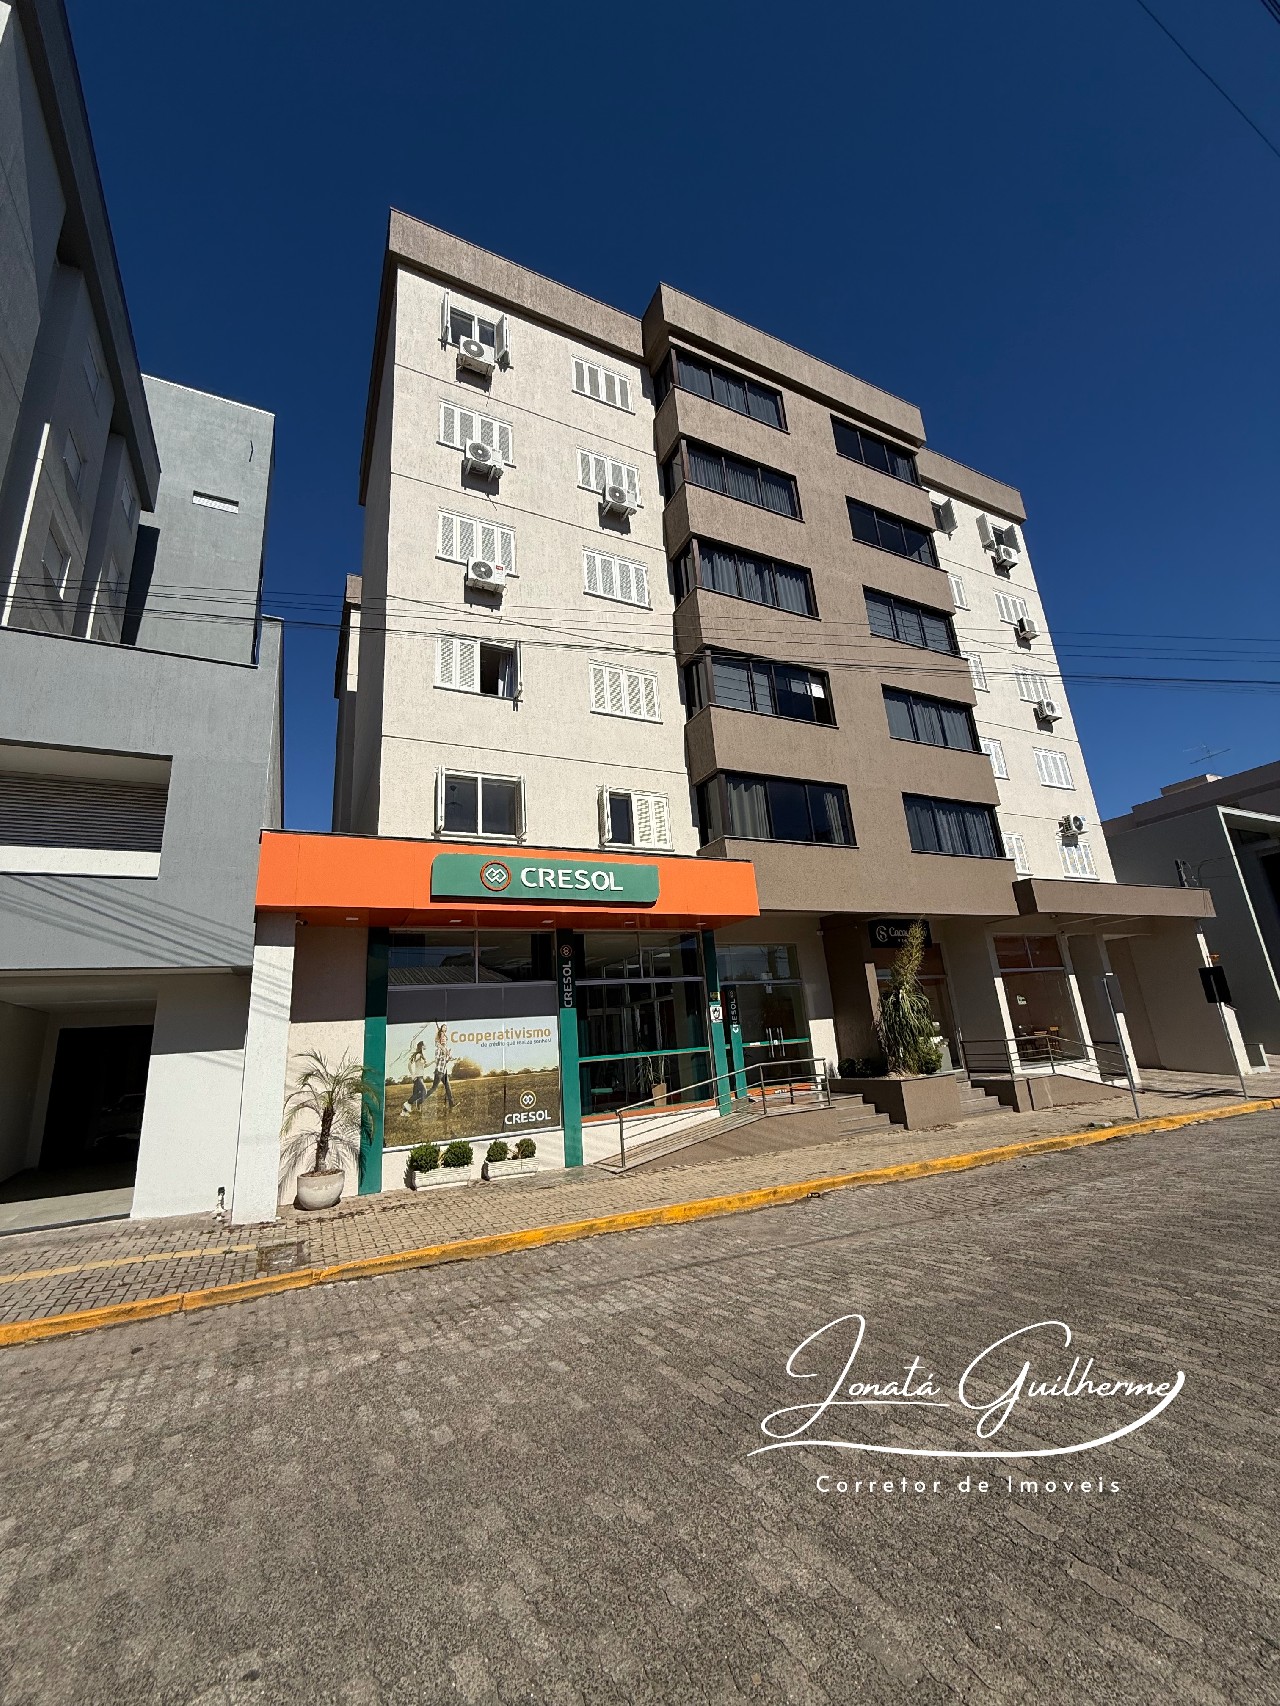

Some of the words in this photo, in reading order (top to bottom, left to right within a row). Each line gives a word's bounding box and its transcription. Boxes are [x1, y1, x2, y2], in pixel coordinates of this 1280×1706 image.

[520, 867, 624, 892] CRESOL
[562, 960, 573, 1008] CRESOL
[730, 998, 739, 1034] CRESOL
[450, 1027, 552, 1044] Cooperativismo
[504, 1109, 552, 1125] CRESOL
